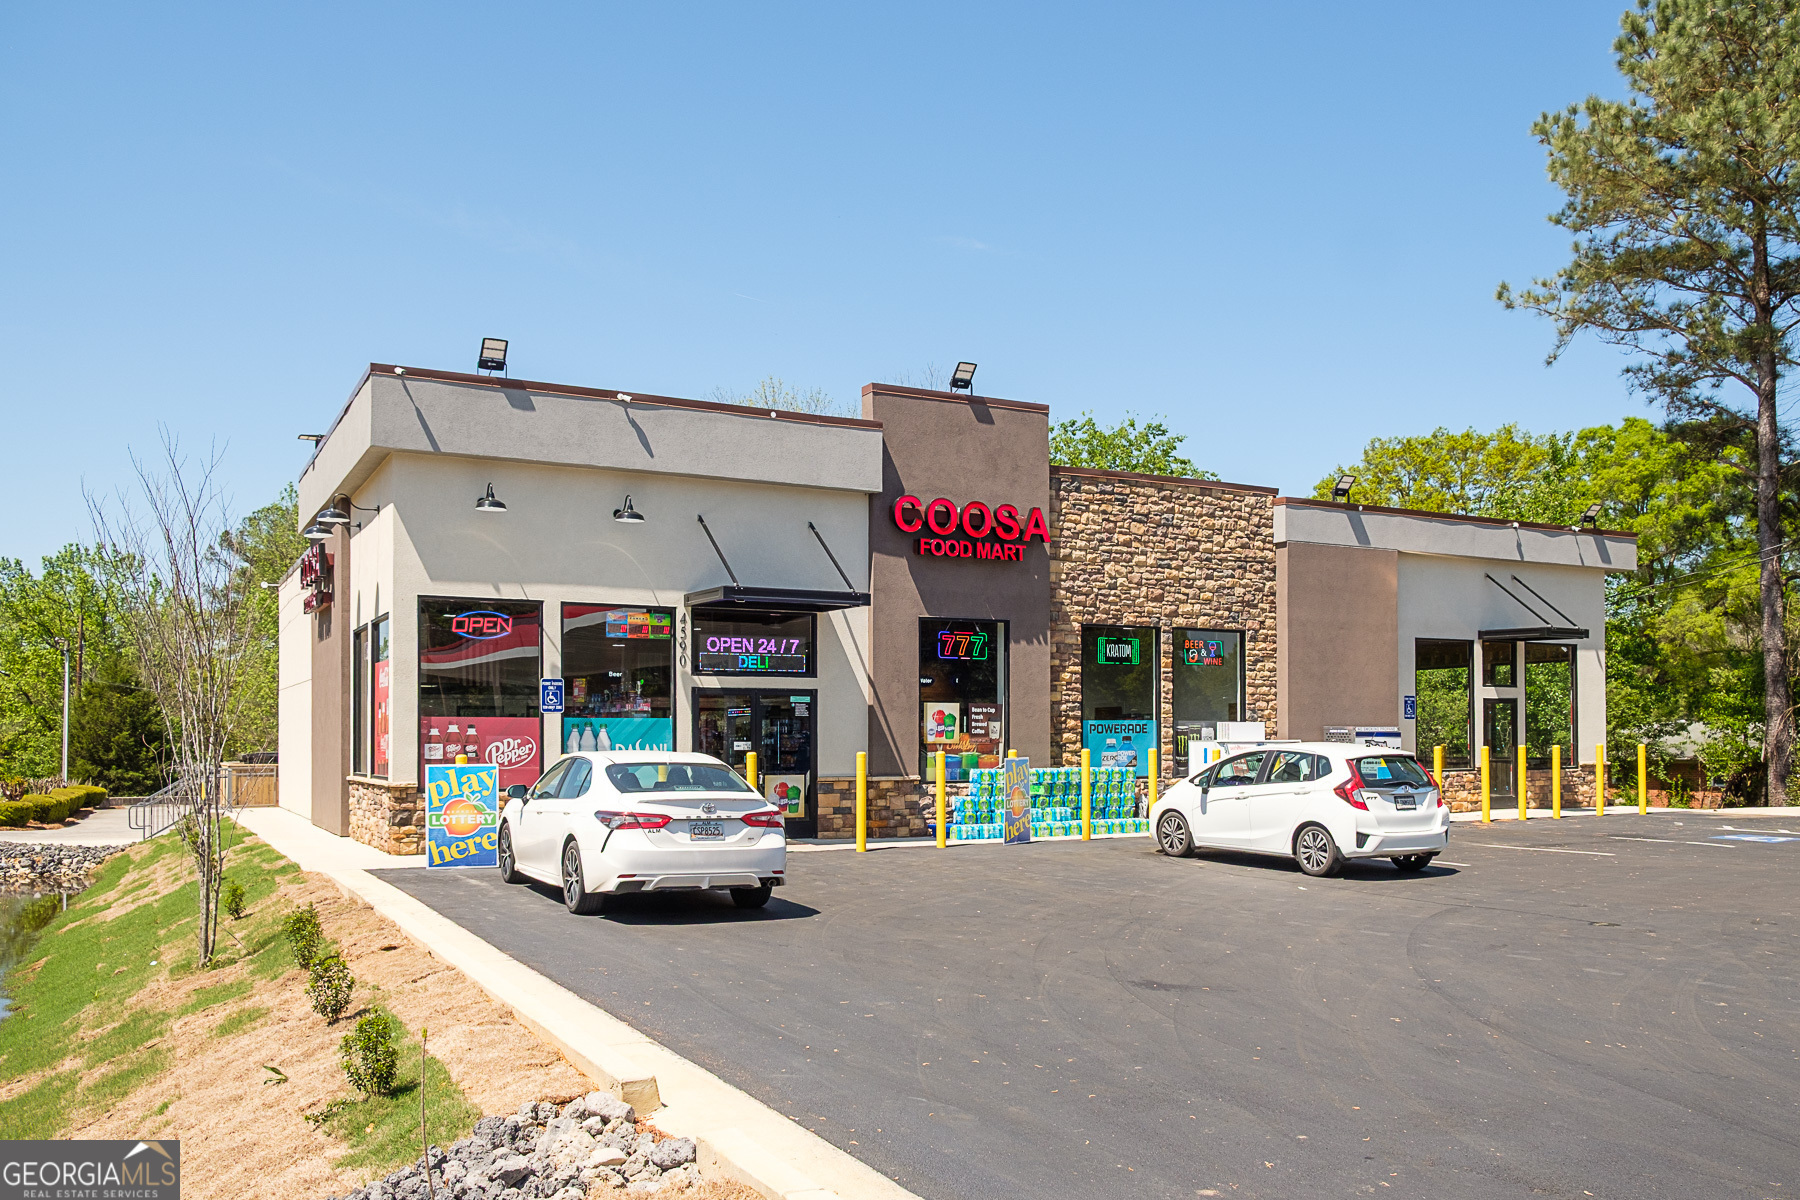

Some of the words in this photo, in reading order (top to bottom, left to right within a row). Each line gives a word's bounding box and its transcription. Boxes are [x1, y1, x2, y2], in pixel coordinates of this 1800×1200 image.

[893, 495, 1051, 543] COOSA
[919, 538, 973, 558] FOOD
[976, 542, 1027, 562] MART
[452, 617, 512, 633] OPEN
[680, 612, 688, 669] 4590
[706, 637, 754, 653] OPEN
[942, 634, 984, 656] 777
[1184, 639, 1204, 649] BEER
[1106, 643, 1132, 658] KRATOM
[1200, 648, 1208, 657] &
[738, 655, 769, 669] DELI
[1203, 657, 1223, 666] WINE
[1089, 723, 1148, 735] POWERADE
[503, 737, 521, 753] Dr
[486, 741, 532, 766] Pepper
[1005, 761, 1029, 794] play
[429, 769, 497, 808] play
[431, 814, 494, 825] LOTTERY
[1004, 812, 1031, 842] here
[429, 832, 497, 866] here
